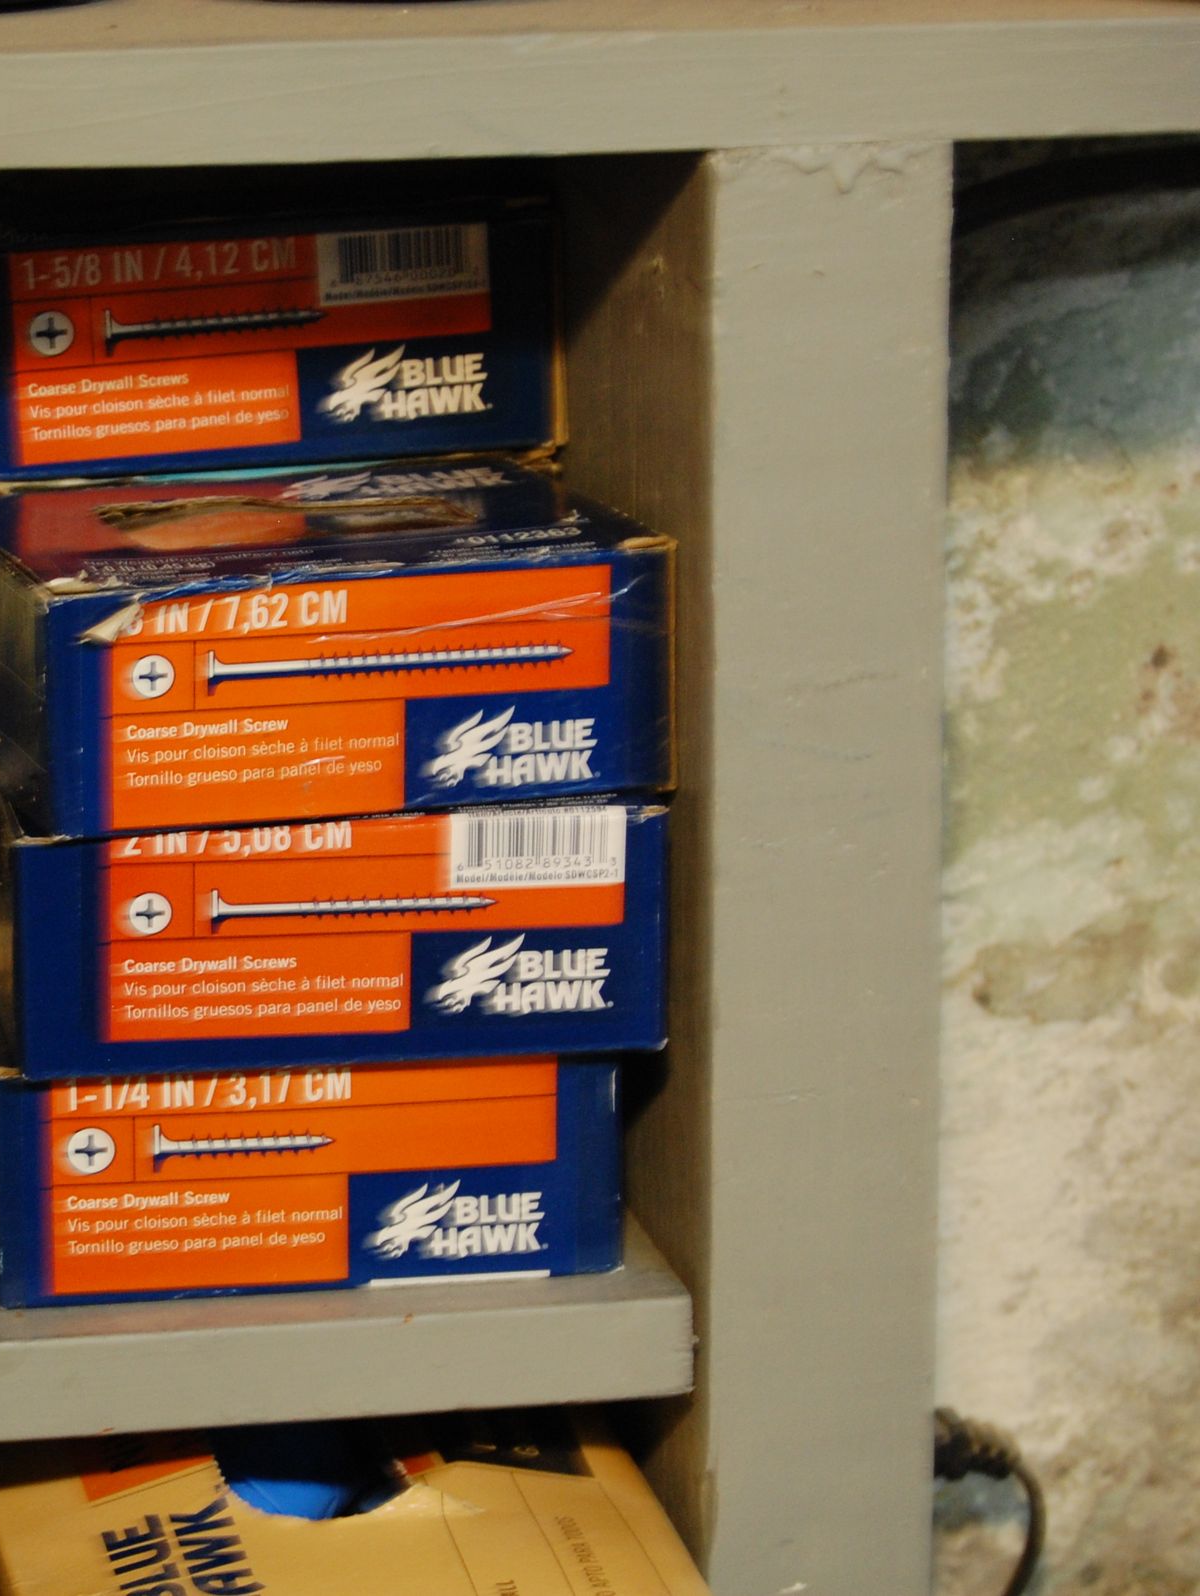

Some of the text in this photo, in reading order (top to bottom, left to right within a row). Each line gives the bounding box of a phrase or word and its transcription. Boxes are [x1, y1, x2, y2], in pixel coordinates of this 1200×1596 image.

[23, 236, 296, 290] 1-5/8 IN / 4,12 CM
[28, 372, 189, 398] Coarse Drywall Screws
[400, 353, 488, 387] BLUE
[30, 384, 289, 422] Vis pour cloison sèche à filet normal
[380, 382, 487, 420] HAWK
[31, 407, 289, 441] Tornillos gruesos para panel de yeso
[156, 602, 189, 634] IN
[198, 599, 214, 632] /
[219, 592, 289, 634] 7,62
[301, 590, 348, 624] CM
[126, 717, 288, 739] Coarse Drywall Screw
[510, 718, 598, 752] BLUE
[127, 732, 399, 766] Vis pour cloison sèche à filet normal
[127, 760, 382, 787] Tornillo grueso para panel de yeso
[485, 750, 593, 786] HAWK
[155, 831, 187, 855] IN
[198, 830, 210, 855] /
[305, 821, 352, 851] CM
[485, 858, 533, 871] 51082
[543, 856, 592, 869] 89343
[124, 955, 297, 974] Coarse Drywall Screws
[519, 948, 612, 980] BLUE
[124, 973, 404, 1000] Vis pour cloison sèche à filet normal
[495, 979, 606, 1014] HAWK
[125, 997, 401, 1020] Tornillos gruesos para panel de yeso
[66, 1068, 352, 1112] 1-1/4 IN / 3,17 CM
[67, 1190, 230, 1210] Coarse Drywall Screw
[454, 1192, 546, 1226] BLUE
[68, 1207, 343, 1234] Vis pour cloison sèche à filet normal
[68, 1231, 325, 1255] Tornillo grueso para panel de yeso
[429, 1222, 542, 1258] HAWK
[169, 1497, 266, 1596] AWK
